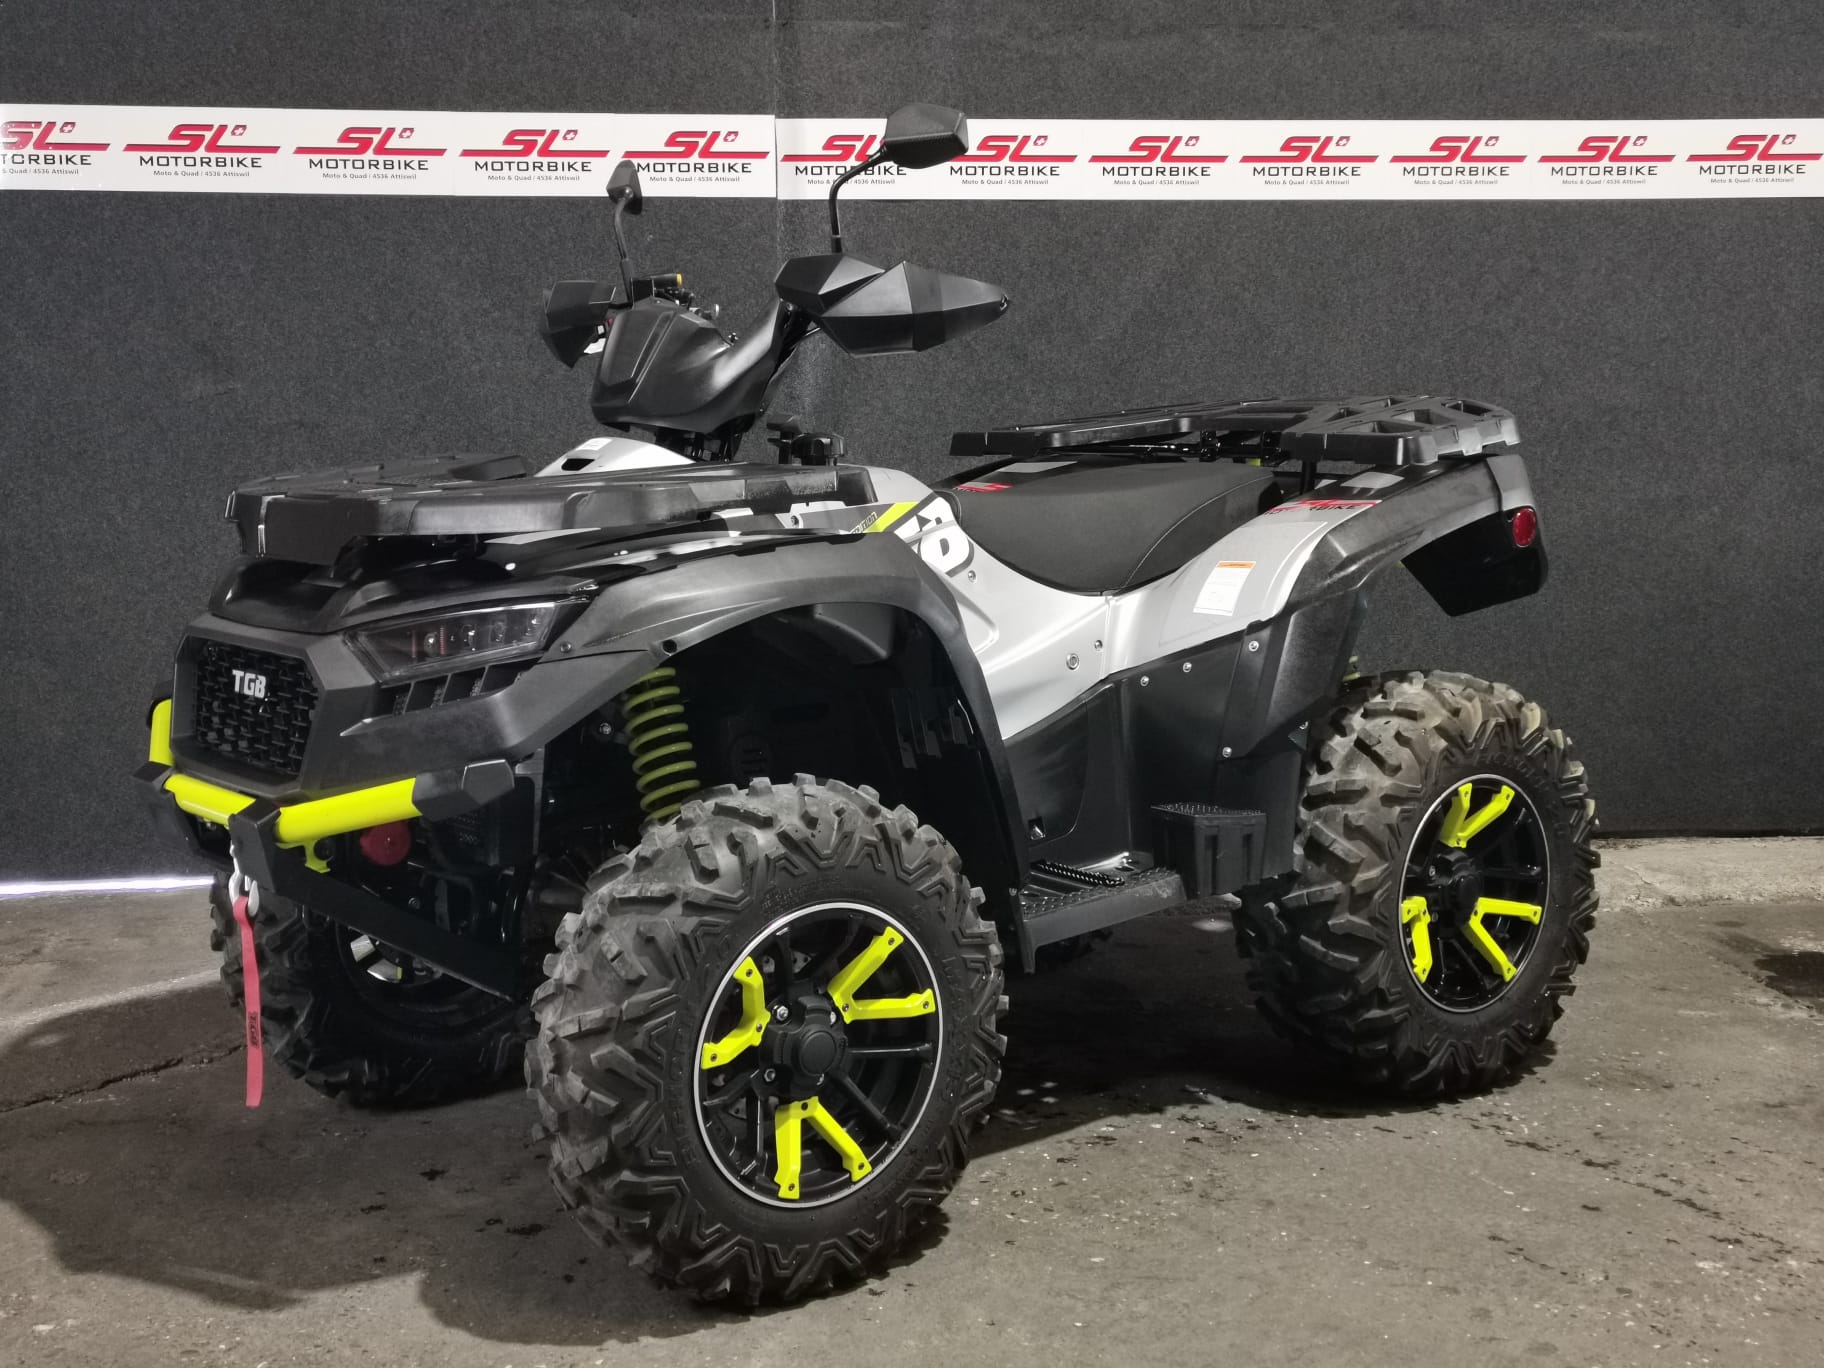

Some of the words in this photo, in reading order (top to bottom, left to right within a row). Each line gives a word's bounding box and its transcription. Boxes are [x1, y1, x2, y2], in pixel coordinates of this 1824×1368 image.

[139, 156, 262, 168] MOTORBIKE
[309, 158, 429, 170] MOTORBIKE
[475, 161, 592, 172] MOTORBIKE
[637, 163, 752, 173] MOTORBIKE
[795, 166, 907, 176] MOTOBIKE
[950, 166, 1060, 177] MOTORBIKE
[1103, 166, 1211, 176] MOTORBIKE
[1253, 166, 1361, 176] MOTORBIKE
[1403, 166, 1510, 176] MOTORBIKE
[1552, 166, 1658, 176] MOTORBIKE
[1699, 164, 1806, 175] MOTORBIKE
[232, 669, 267, 698] TGB
